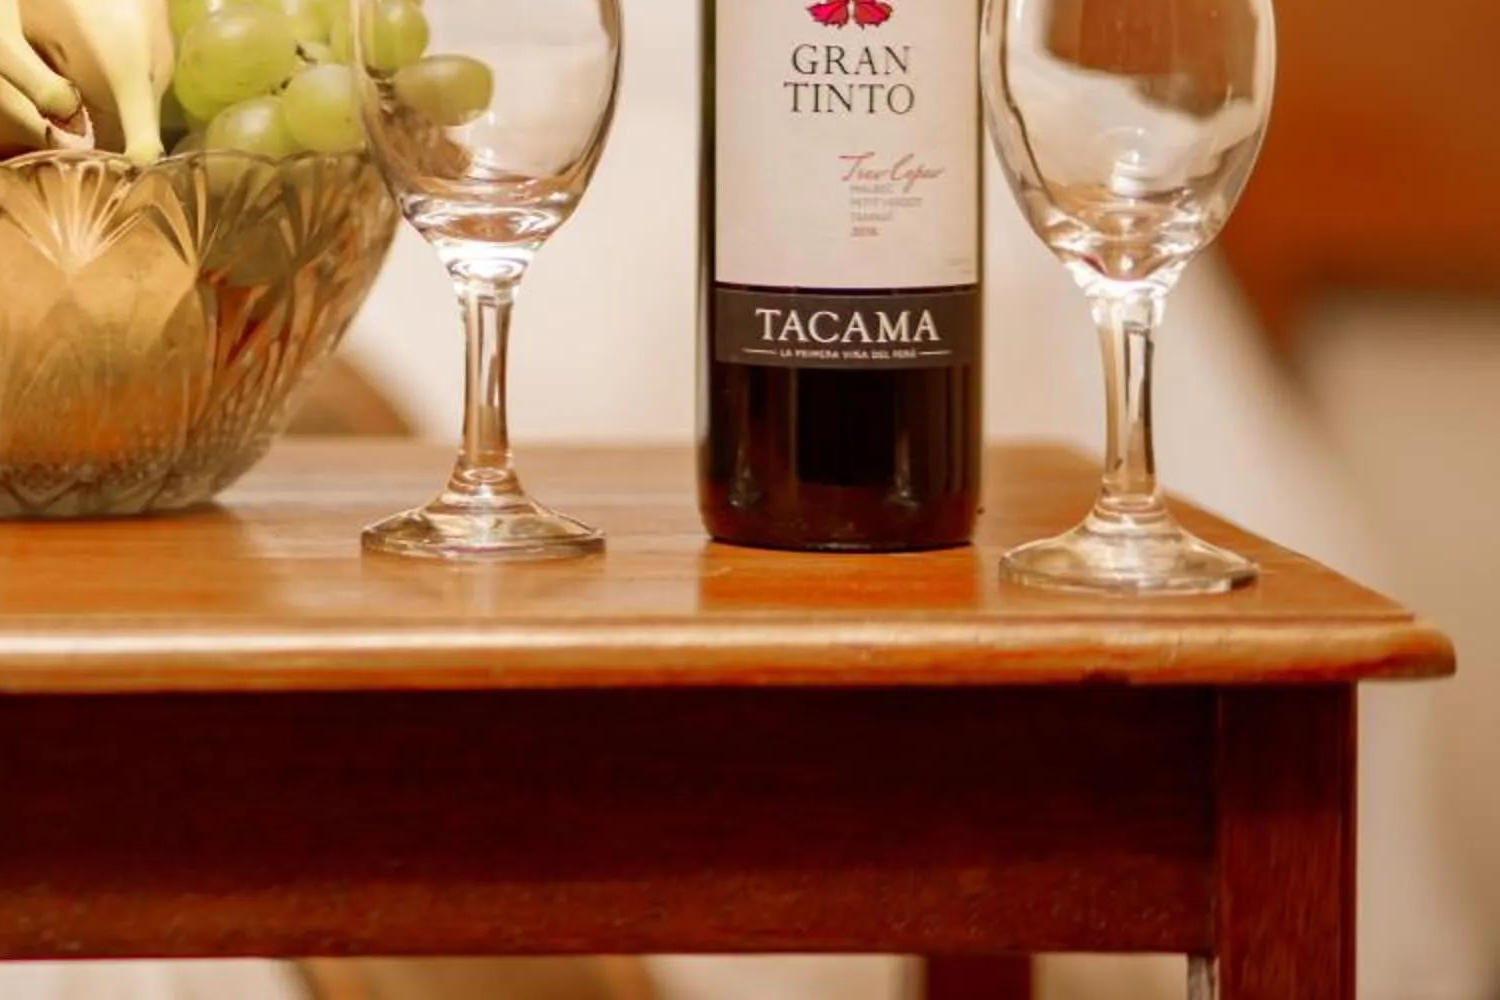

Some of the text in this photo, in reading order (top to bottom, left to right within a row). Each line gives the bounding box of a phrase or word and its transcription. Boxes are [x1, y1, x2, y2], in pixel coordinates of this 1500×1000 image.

[791, 43, 912, 75] GRAN
[783, 81, 915, 115] TINTO
[755, 308, 941, 343] TACAMA
[780, 348, 793, 358] LA
